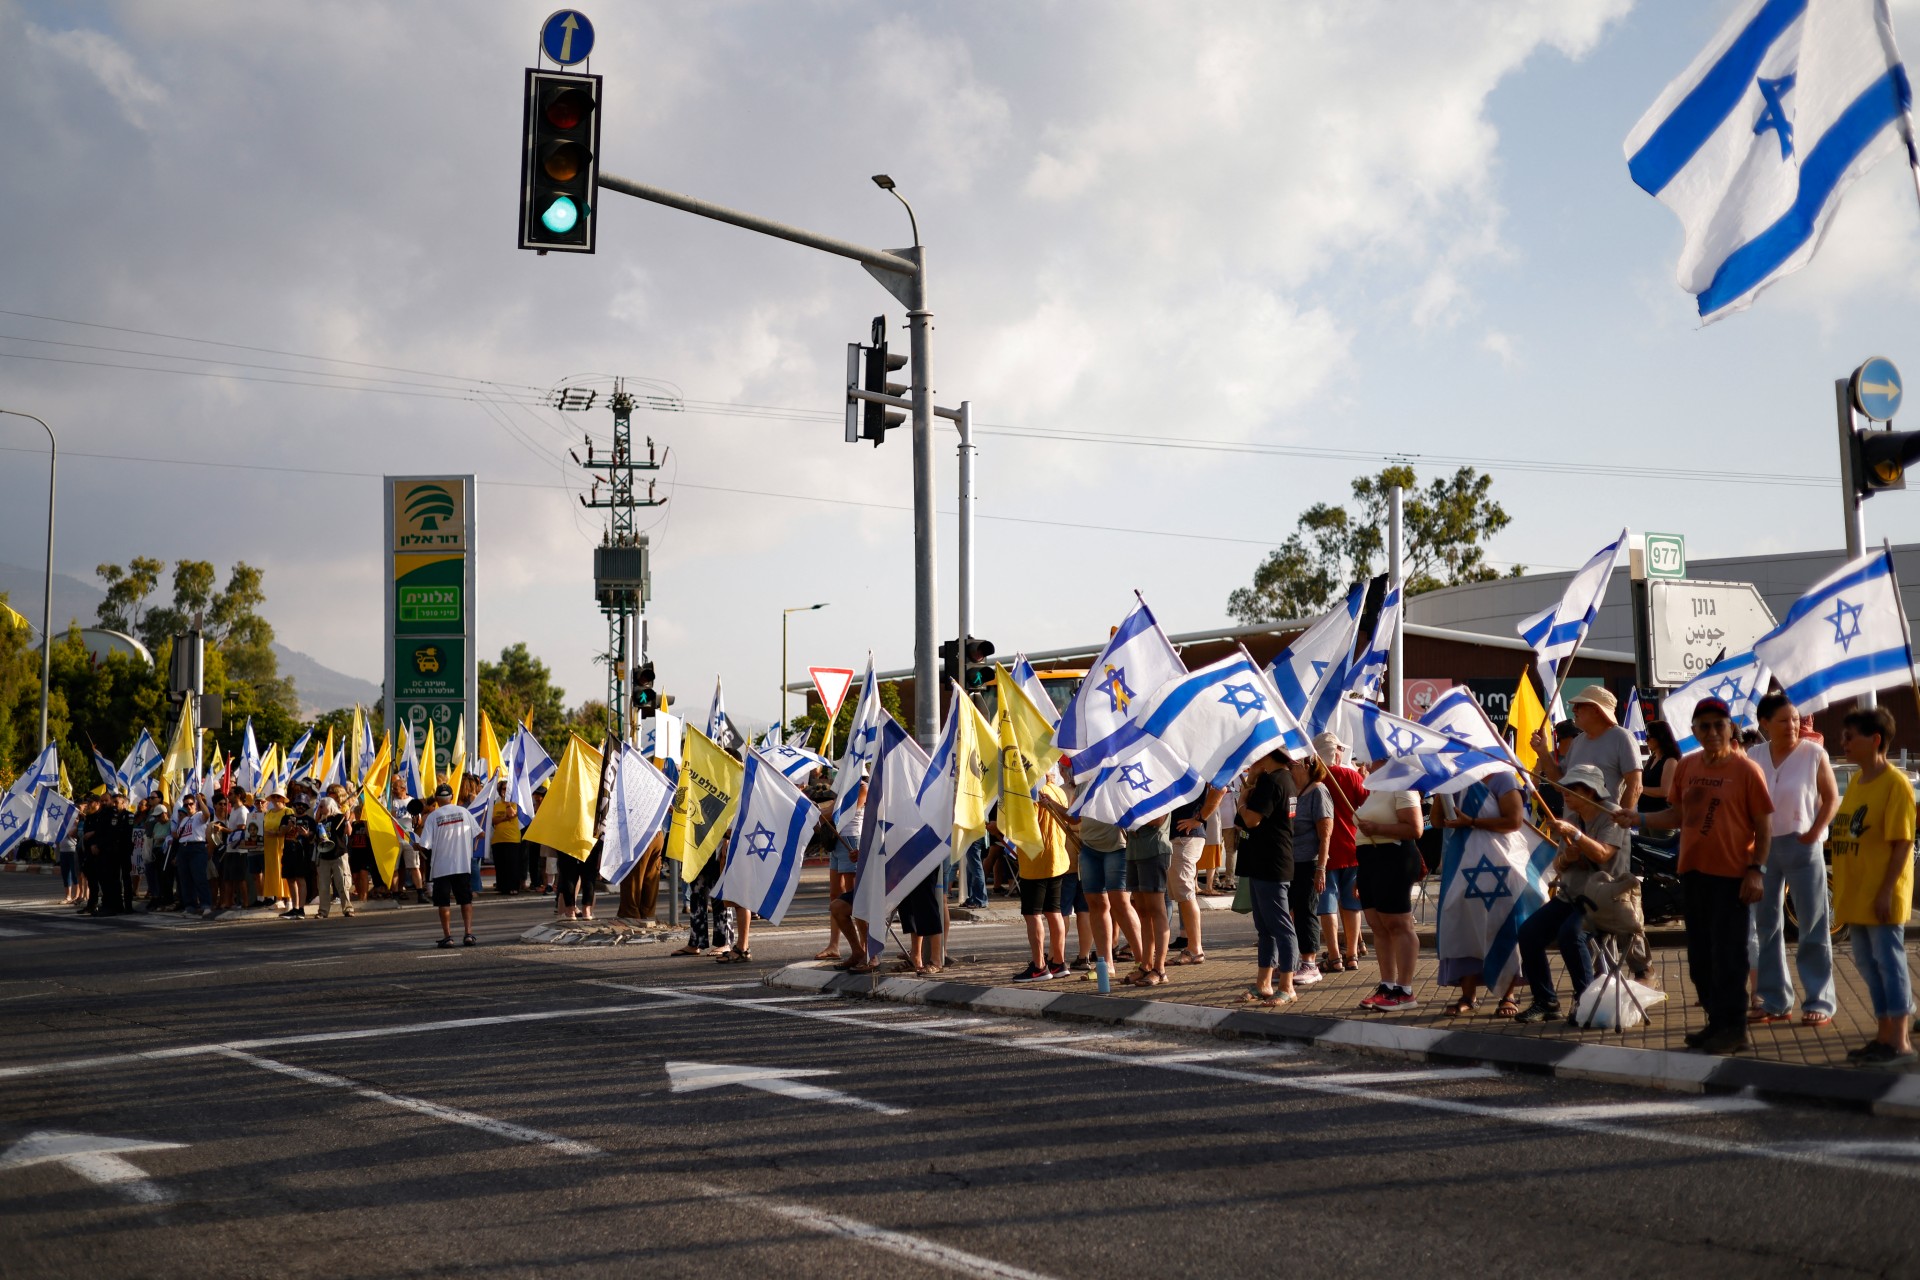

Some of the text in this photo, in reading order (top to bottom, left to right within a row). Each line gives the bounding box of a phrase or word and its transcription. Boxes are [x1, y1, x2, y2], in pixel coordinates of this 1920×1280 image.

[400, 534, 459, 546] דור אלון
[1653, 547, 1678, 565] 977
[406, 590, 454, 603] אלונית
[1691, 597, 1716, 617] גונן
[1683, 652, 1713, 670] Gon
[698, 777, 718, 794] כולם
[1688, 776, 1724, 787] Virtual
[717, 791, 731, 803] את
[1699, 798, 1720, 836] Reality
